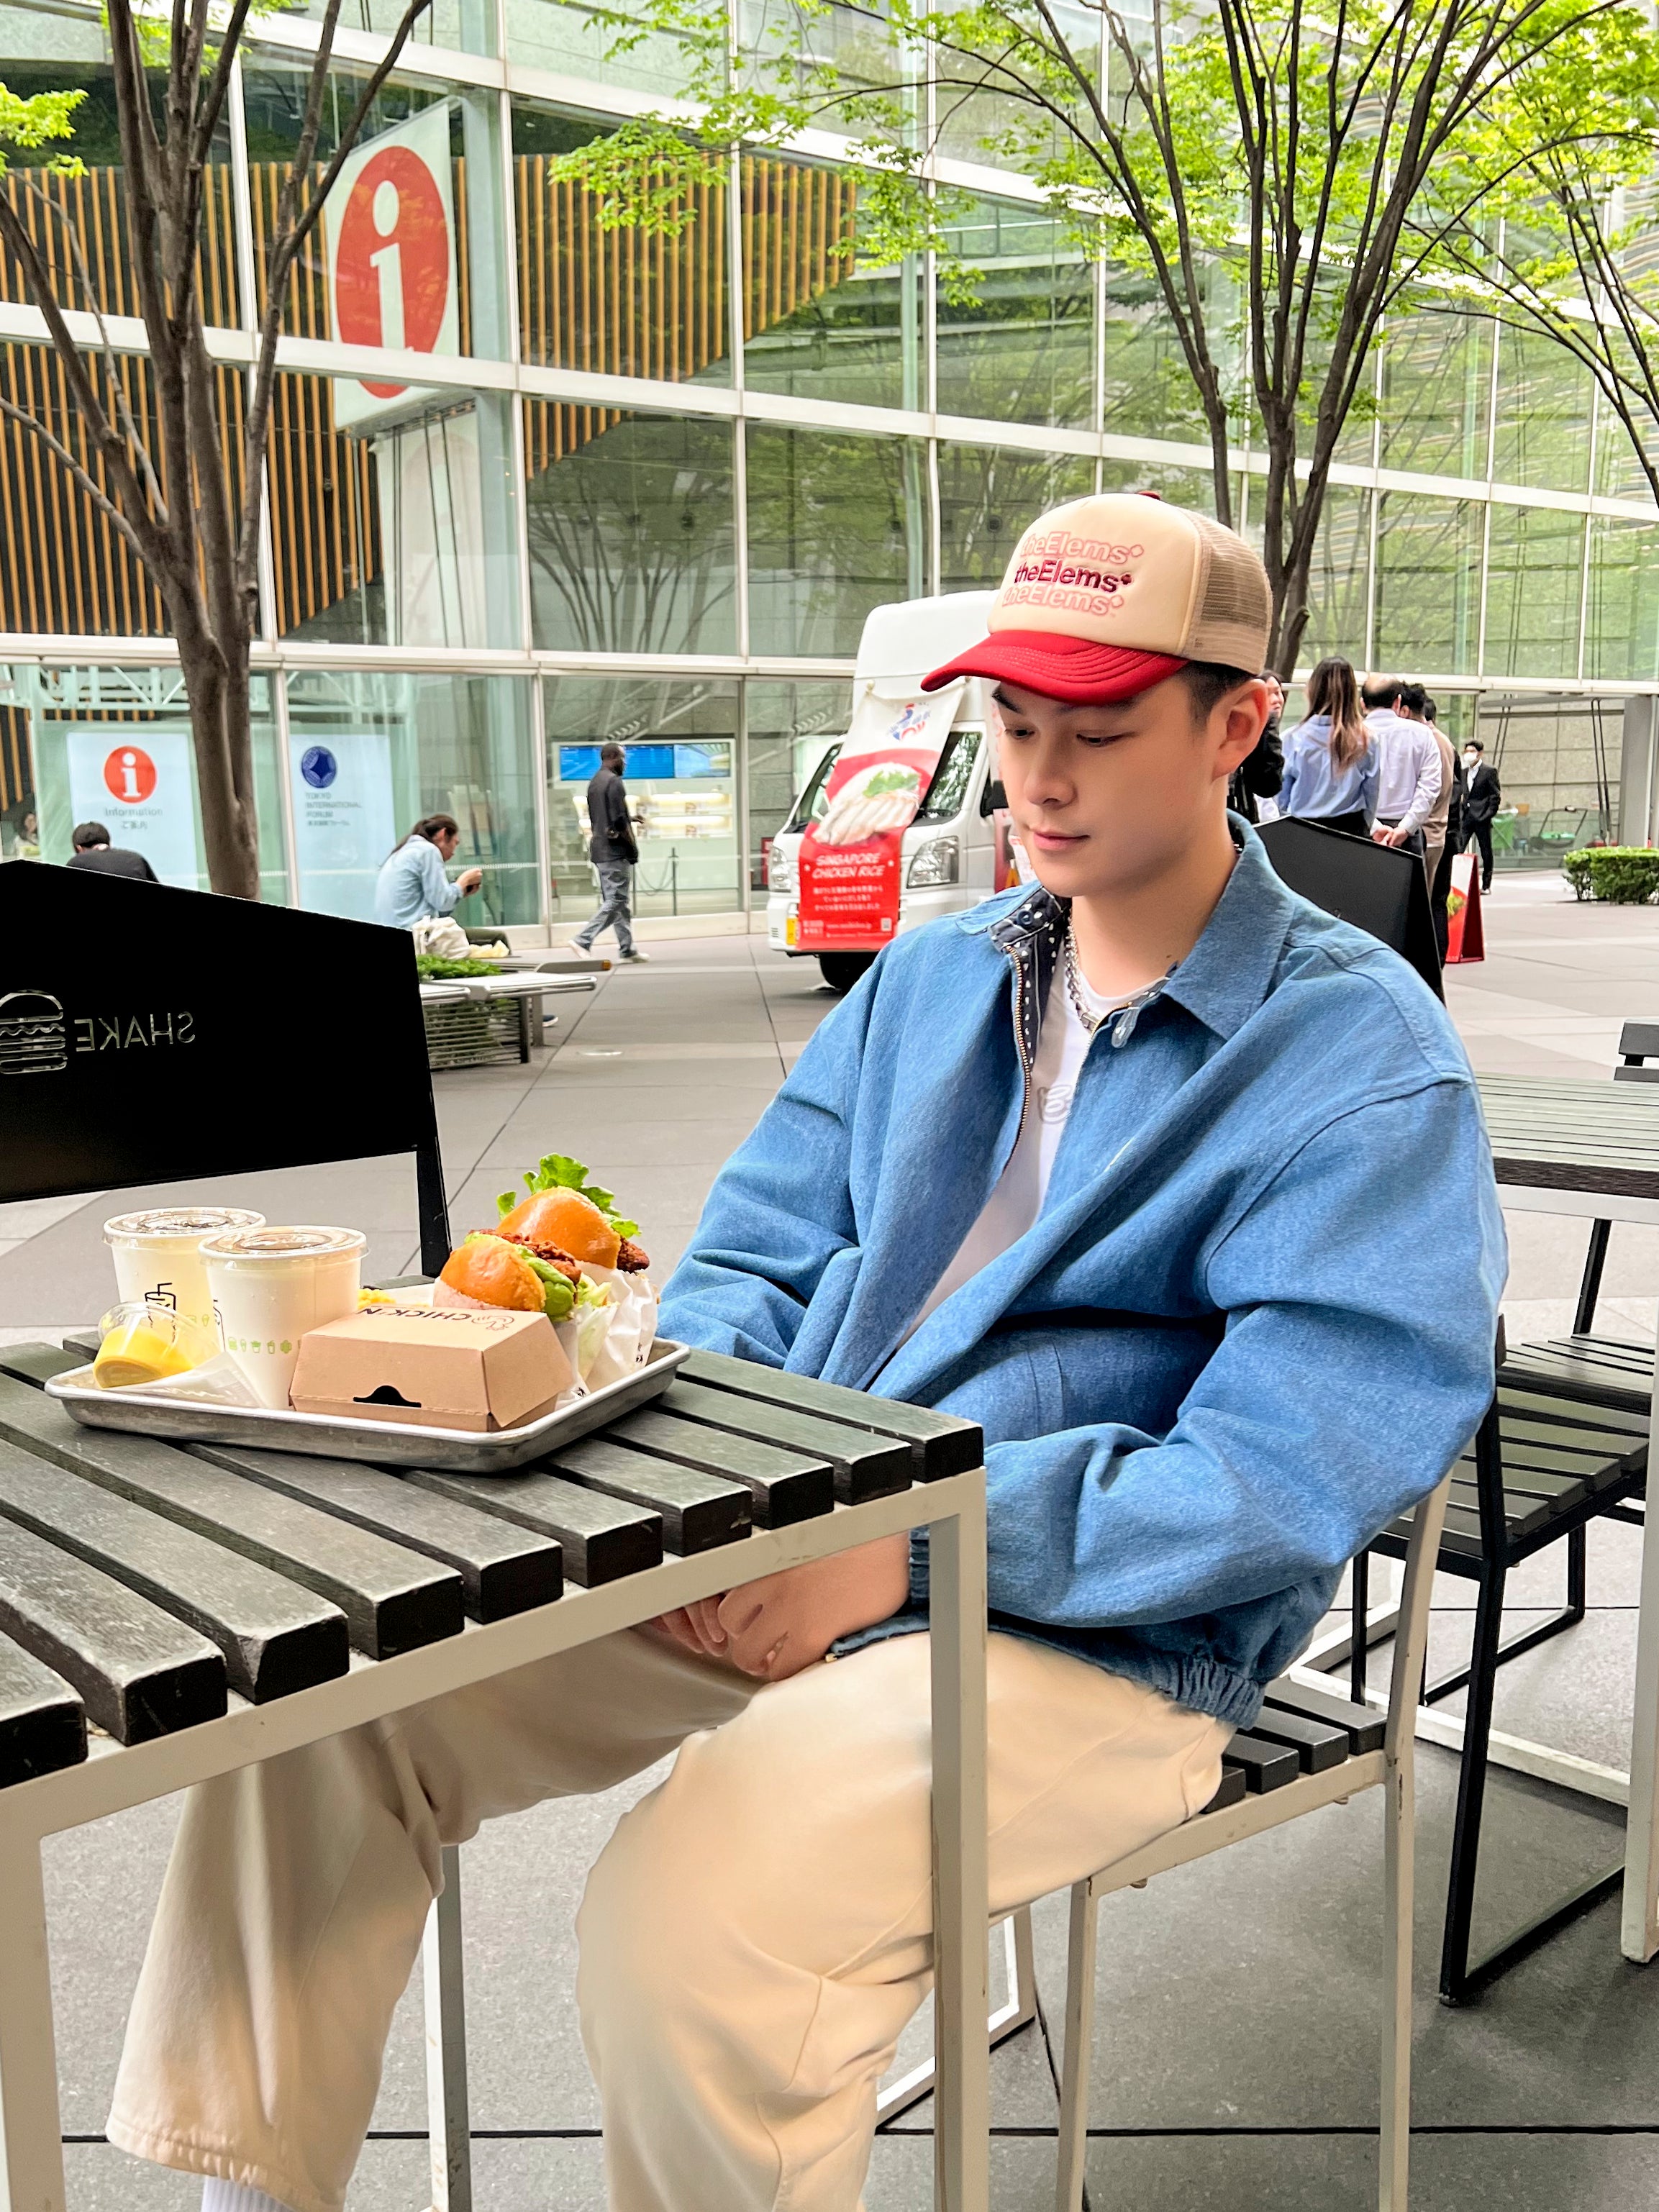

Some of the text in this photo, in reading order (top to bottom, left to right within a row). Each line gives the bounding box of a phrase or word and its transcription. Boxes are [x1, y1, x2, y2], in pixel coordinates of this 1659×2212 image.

[104, 807, 163, 816] Information
[816, 852, 881, 866] SINGAPORE
[812, 865, 886, 879] CHICKEN RICE
